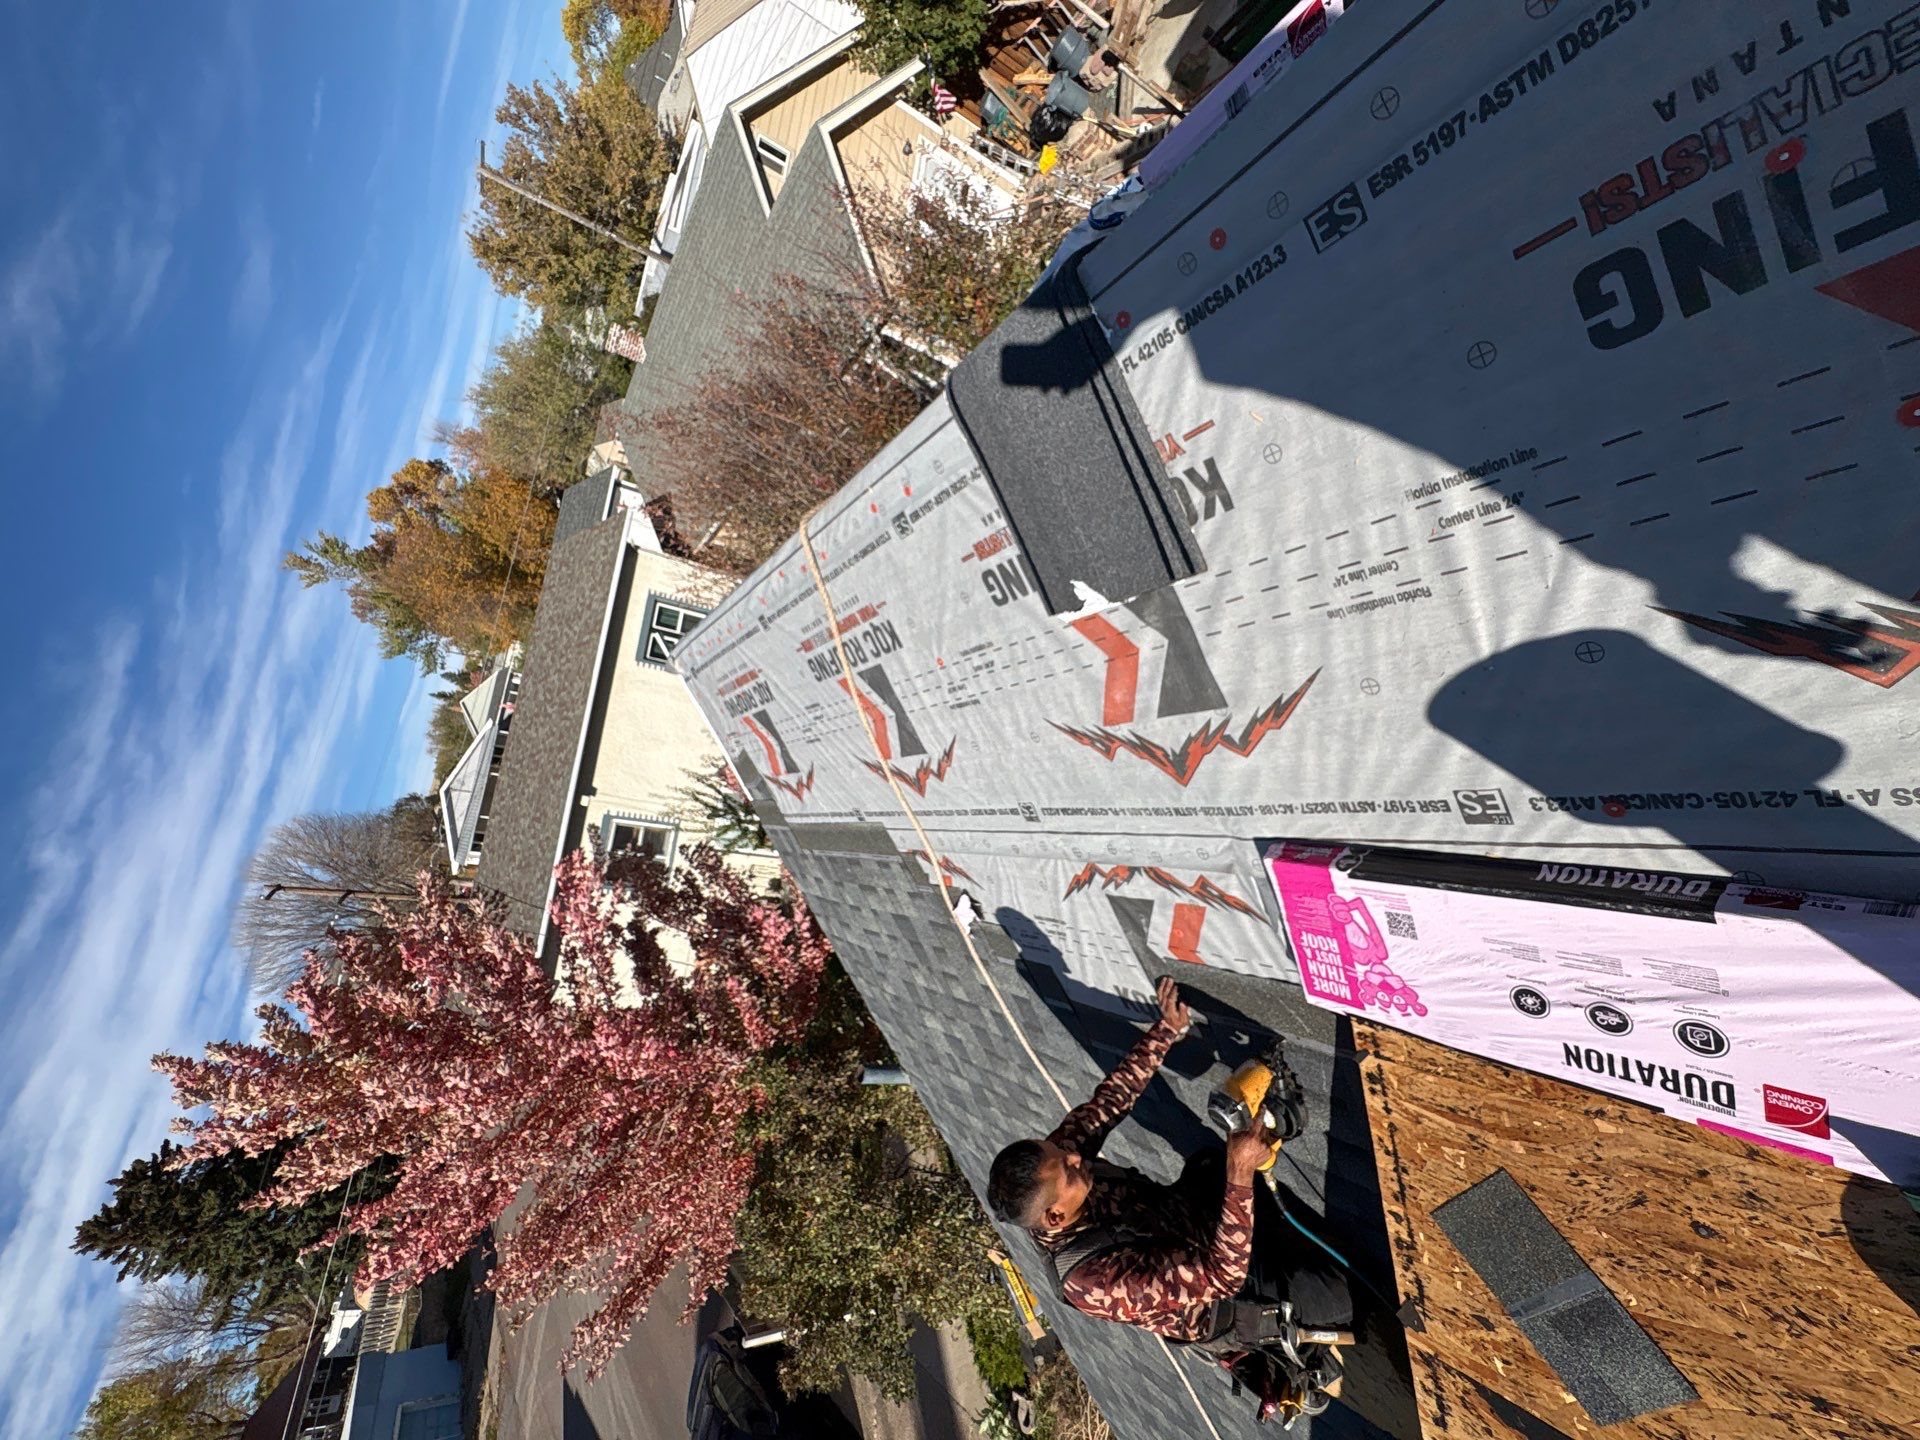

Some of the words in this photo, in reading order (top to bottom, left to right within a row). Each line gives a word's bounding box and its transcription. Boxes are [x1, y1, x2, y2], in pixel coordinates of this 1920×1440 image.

[1366, 152, 1415, 199] ESR
[1556, 0, 1651, 65] D825
[1235, 243, 1288, 295] A123.3
[1404, 481, 1442, 504] Florida
[1442, 455, 1510, 490] Installation
[1509, 446, 1538, 467] Line
[1437, 506, 1475, 530] Center
[1477, 499, 1502, 518] Line
[1368, 560, 1400, 577] Center
[1345, 595, 1397, 615] Installation
[1396, 586, 1433, 603] Florida
[862, 619, 904, 659] KQC
[1416, 799, 1452, 813] ESR
[1455, 789, 1507, 816] ES
[1528, 792, 1596, 812] A123.3
[1534, 863, 1711, 897] DURATION
[1300, 930, 1341, 954] ROOF
[1302, 946, 1313, 961] A
[1315, 949, 1343, 968] JUST
[1306, 959, 1349, 985] THAN
[1311, 975, 1352, 1000] MORE
[1562, 1042, 1737, 1111] DURATION
[1766, 1089, 1824, 1111] CORNING
[1766, 1096, 1814, 1116] OWENS
